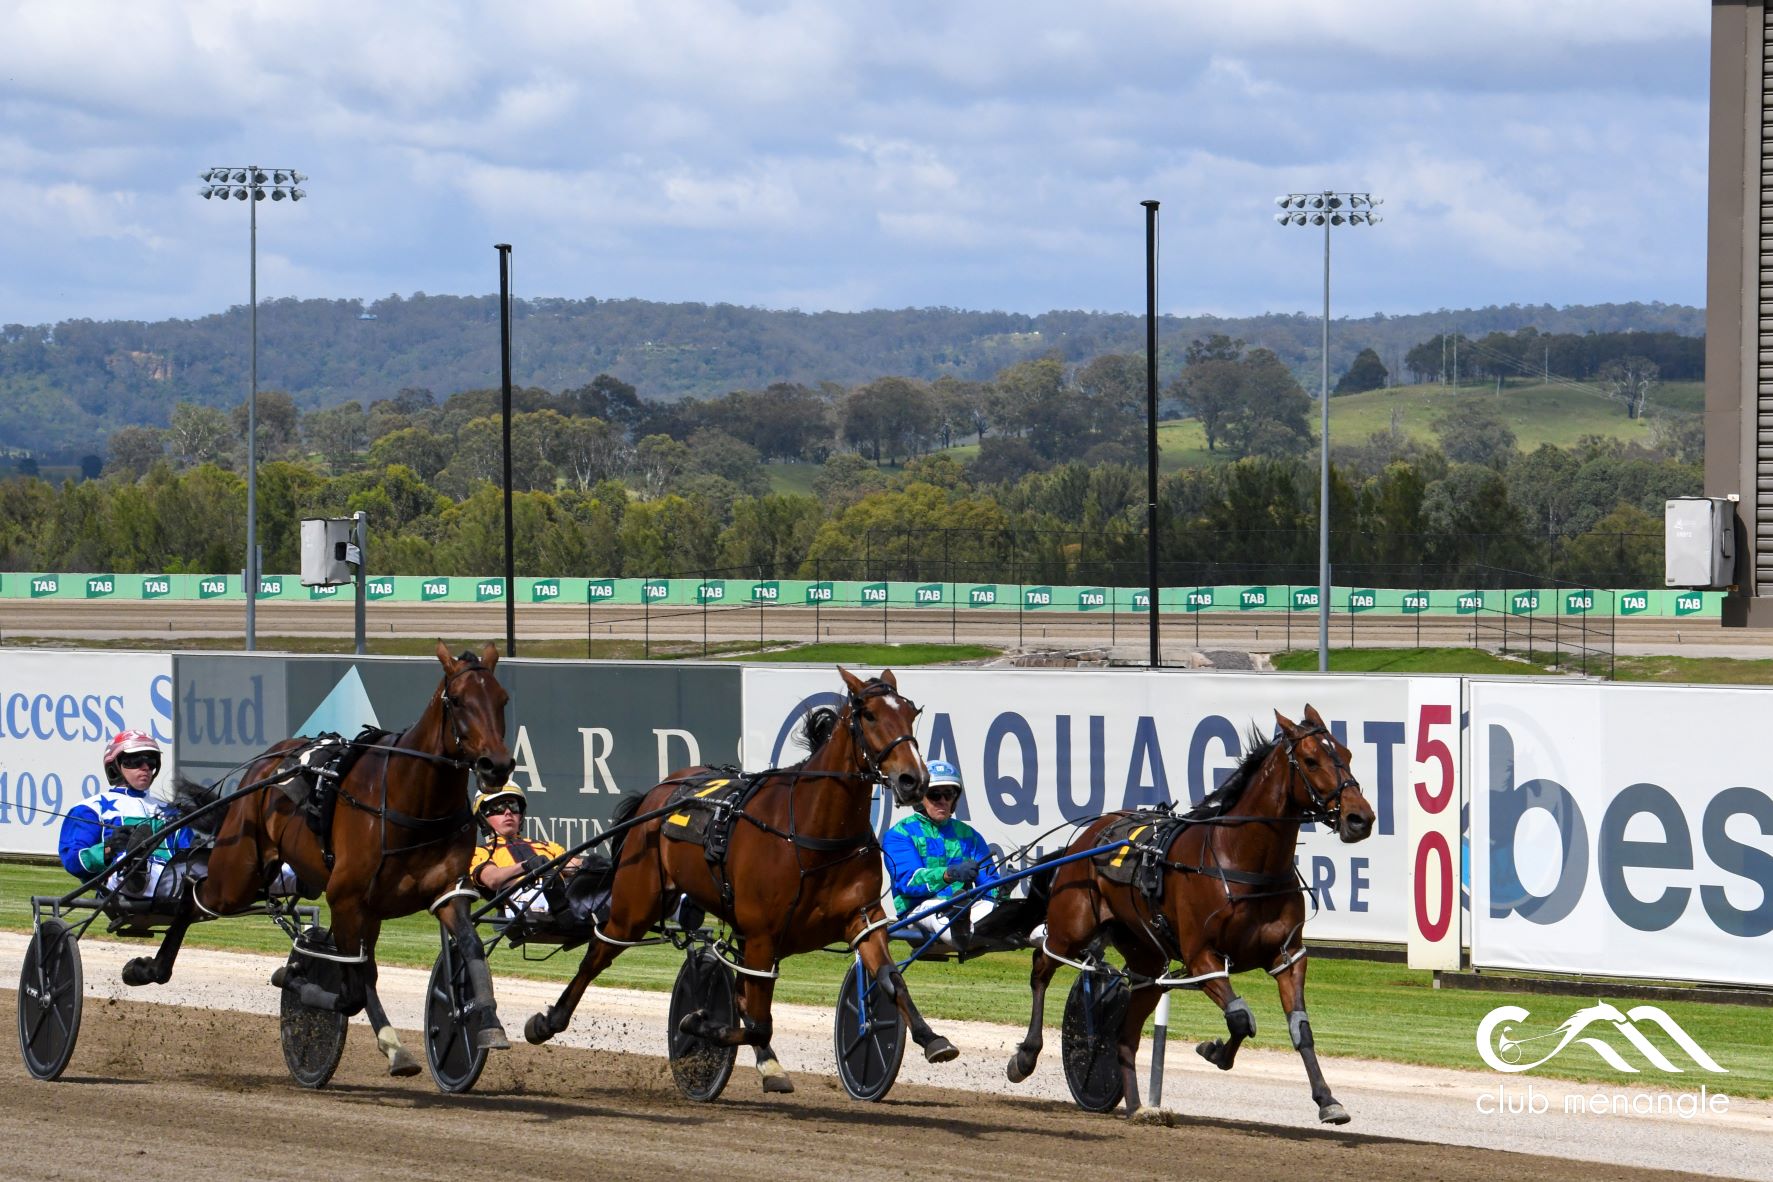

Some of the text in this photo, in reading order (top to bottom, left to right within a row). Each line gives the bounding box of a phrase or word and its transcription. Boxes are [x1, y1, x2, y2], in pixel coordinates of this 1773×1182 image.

[33, 581, 57, 591] TAB
[89, 582, 113, 592] TAB
[144, 582, 169, 593] TAB
[201, 582, 225, 593] TAB
[368, 583, 393, 594] TAB
[424, 584, 447, 595] TAB
[478, 585, 502, 595] TAB
[534, 585, 558, 596] TAB
[589, 585, 613, 597] TAB
[643, 586, 667, 597] TAB
[700, 587, 723, 598] TAB
[754, 587, 777, 598] TAB
[808, 588, 831, 599] TAB
[863, 589, 886, 600] TAB
[917, 590, 941, 601] TAB
[971, 591, 995, 602] TAB
[1026, 592, 1050, 603] TAB
[1081, 594, 1104, 605] TAB
[1134, 595, 1150, 606] TA
[1189, 594, 1212, 605] TAB
[1242, 593, 1265, 604] TAB
[1295, 594, 1319, 605] TAB
[1350, 595, 1374, 606] TAB
[1404, 597, 1428, 608] TAB
[1459, 597, 1482, 608] TAB
[1514, 597, 1538, 608] TAB
[1568, 596, 1592, 608] TAB
[1622, 597, 1646, 609] TAB
[1677, 598, 1701, 609] TAB
[0, 675, 267, 745] ccess Stud
[511, 725, 744, 794] ARD
[926, 711, 1406, 836] AQUAGT
[1414, 704, 1454, 942] 50
[1294, 854, 1370, 912] RE
